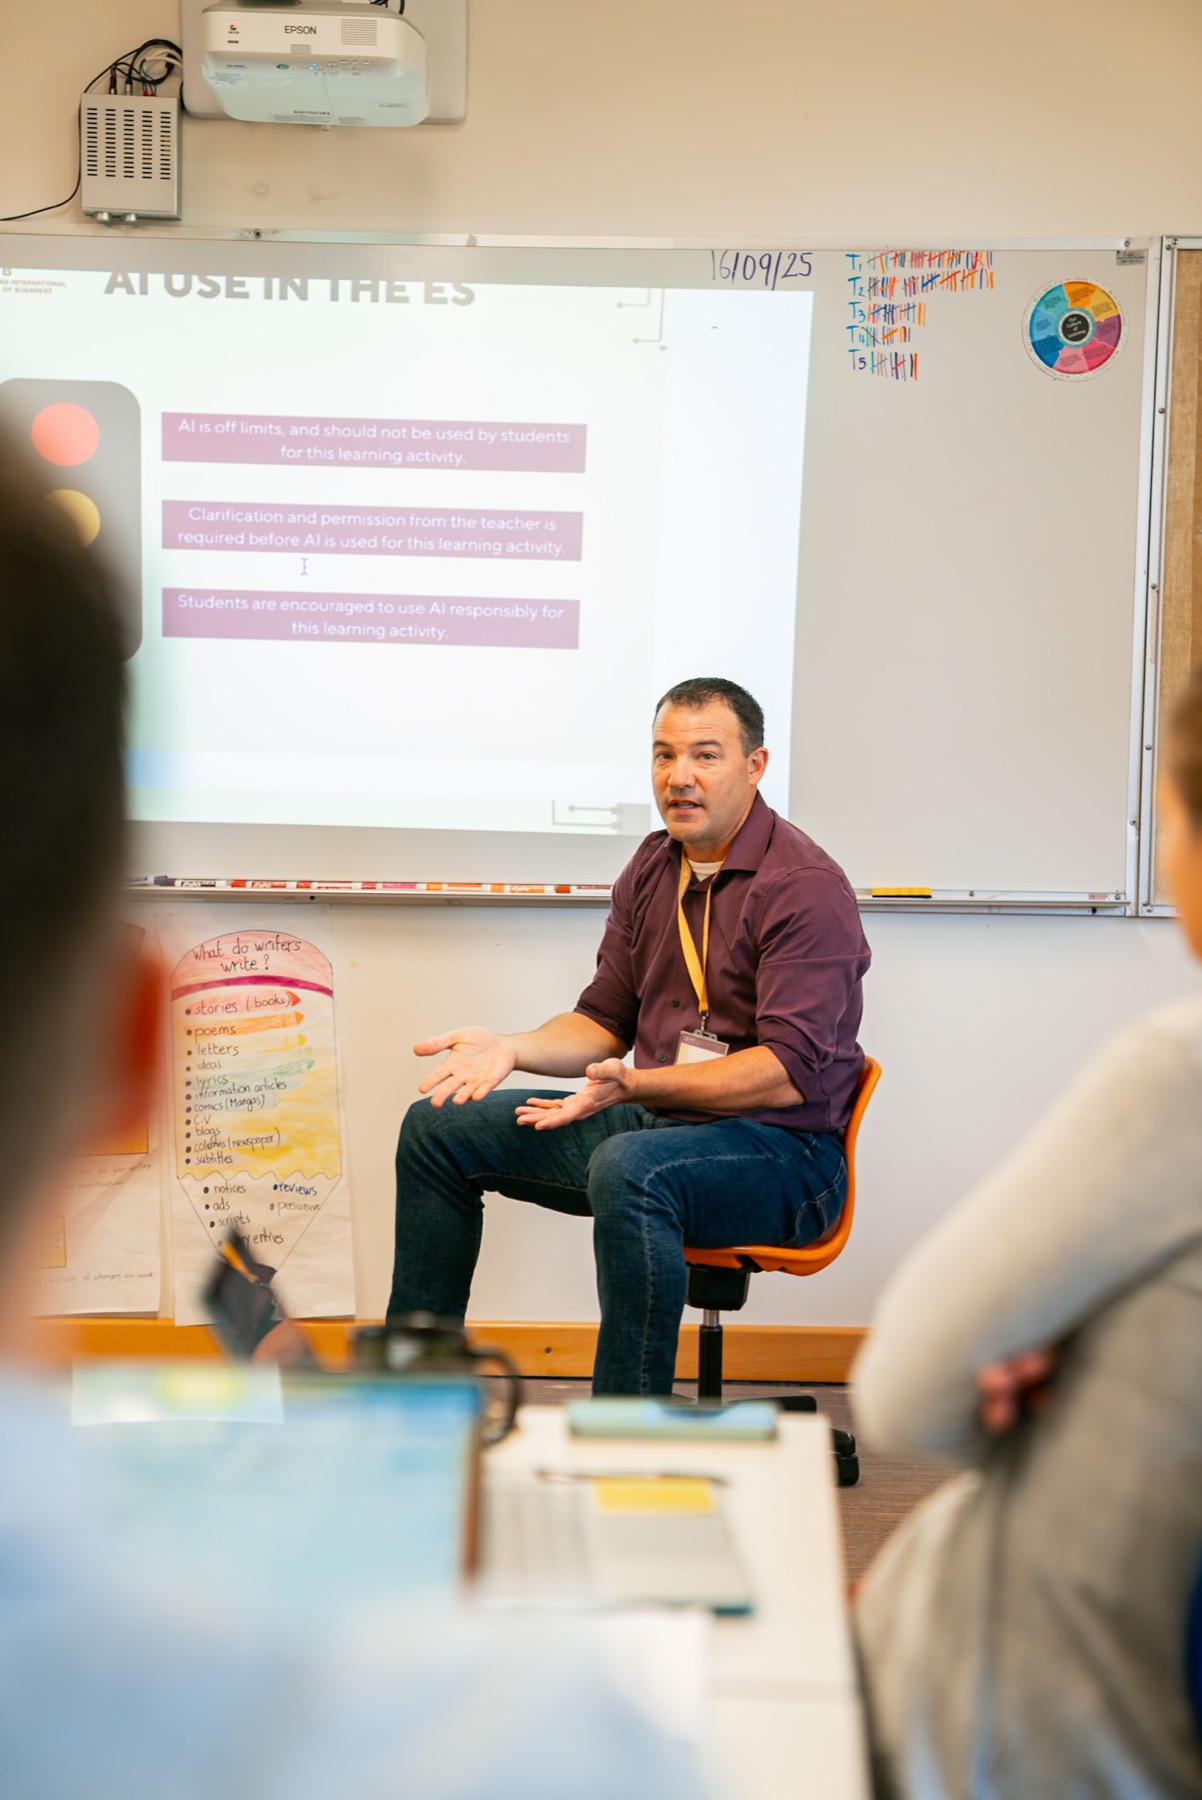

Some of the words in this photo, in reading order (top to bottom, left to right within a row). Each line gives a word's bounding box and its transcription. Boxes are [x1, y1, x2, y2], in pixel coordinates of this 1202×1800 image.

[284, 25, 317, 34] EPSON
[711, 249, 814, 291] 16/09/25
[164, 273, 250, 299] USE
[423, 282, 476, 307] ES
[847, 276, 865, 297] T2
[848, 302, 866, 323] T3
[848, 349, 867, 370] T5
[178, 419, 195, 433] AI
[199, 420, 211, 433] is
[214, 420, 237, 434] off
[240, 421, 285, 437] limits,
[290, 423, 320, 436] and
[323, 424, 376, 438] should
[381, 428, 407, 439] not
[411, 426, 432, 440] be
[436, 428, 473, 441] used
[478, 428, 497, 444] by
[500, 429, 570, 443] students
[280, 445, 303, 459] for
[306, 446, 335, 460] this
[339, 447, 402, 464] learning
[406, 450, 467, 466] activity.
[188, 507, 283, 523] Clarification
[287, 511, 317, 524] and
[321, 513, 405, 527] permission
[409, 514, 446, 528] from
[450, 515, 477, 529] the
[481, 516, 541, 531] teacher
[544, 517, 557, 531] is
[178, 531, 245, 545] required
[249, 532, 299, 546] before
[303, 534, 320, 547] AI
[324, 534, 336, 548] is
[340, 536, 378, 549] used
[382, 536, 405, 548] for
[407, 537, 435, 550] this
[439, 537, 502, 555] learning
[506, 541, 566, 557] activity.
[178, 594, 248, 609] Students
[252, 599, 276, 610] are
[280, 600, 374, 616] encouraged
[379, 602, 394, 614] to
[398, 604, 425, 614] use
[429, 602, 445, 615] AI
[450, 604, 538, 621] responsibly
[542, 605, 565, 619] for
[292, 621, 320, 634] this
[324, 622, 386, 639] learning
[389, 625, 449, 641] activity.
[232, 937, 249, 954] do
[255, 934, 302, 952] writers
[220, 957, 258, 973] write
[195, 1000, 238, 1015] stories
[194, 1026, 236, 1044] poems
[197, 1043, 239, 1056] letters
[197, 1060, 222, 1070] ideas
[195, 1074, 229, 1091] lyrics
[195, 1082, 251, 1099] information
[254, 1077, 287, 1092] articles
[195, 1126, 221, 1144] blogs
[195, 1151, 233, 1165] subtitles
[214, 1180, 246, 1194] notices
[279, 1182, 318, 1196] reviews
[213, 1198, 231, 1211] ads
[218, 1210, 251, 1230] scripts
